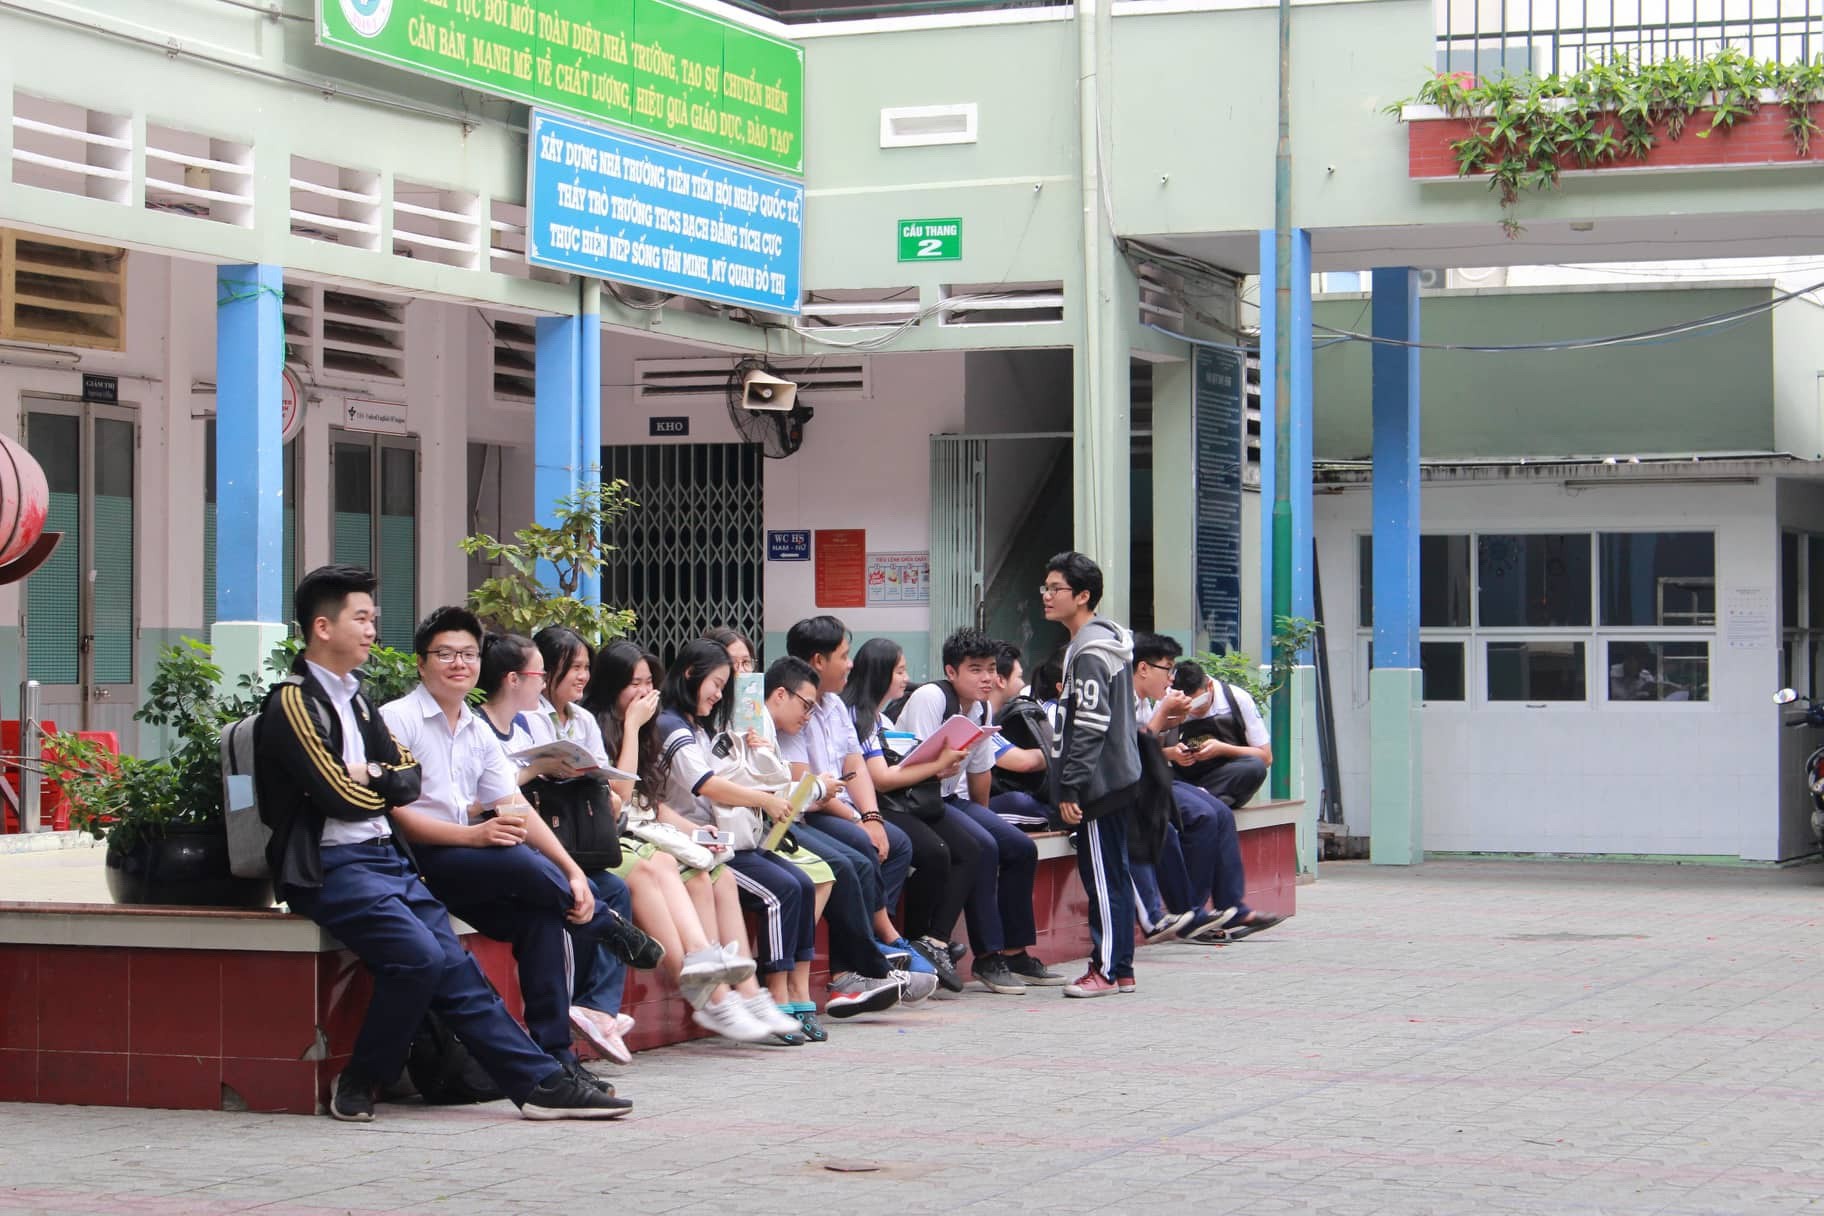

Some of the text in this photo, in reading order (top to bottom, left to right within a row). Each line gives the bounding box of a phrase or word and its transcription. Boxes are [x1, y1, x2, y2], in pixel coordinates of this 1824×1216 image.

[538, 9, 569, 46] TOÀN
[572, 21, 600, 58] DIỆN
[602, 31, 628, 64] NHÀ
[631, 40, 679, 85] TRƯỜNG,
[681, 58, 702, 92] TẠO
[705, 65, 720, 98] SỰ
[472, 37, 511, 75] MẠNH
[555, 56, 590, 97] CHẤT
[592, 72, 632, 115] LƯỢNG,
[636, 84, 665, 123] HIỆU
[691, 101, 717, 134] GIÁO
[720, 112, 745, 145] DỤC,
[747, 115, 768, 148] ĐÀO
[540, 131, 563, 163] XÂY
[565, 141, 597, 174] DỰNG
[598, 147, 621, 178] NHÀ
[622, 154, 665, 189] TRƯỜNG
[691, 168, 713, 202] TIẾN
[714, 176, 732, 211] HỘI
[733, 184, 759, 217] NHẬP
[760, 187, 786, 221] QUỐC
[588, 185, 609, 217] TRÒ
[611, 192, 653, 228] TRƯỜNG
[655, 206, 681, 234] THCS
[682, 213, 709, 243] BẠCH
[710, 211, 738, 248] ĐẰNG
[739, 221, 761, 253] TÍCH
[762, 232, 782, 261] CỰC
[917, 239, 943, 257] 2
[925, 224, 957, 237] THANG
[550, 222, 581, 257] THỰC
[582, 225, 608, 262] HIỆN
[609, 228, 631, 262] NẾP
[631, 233, 661, 269] SỐNG
[683, 252, 711, 285] MINH,
[728, 262, 755, 287] QUAN
[755, 263, 769, 292] ĐÔ
[770, 271, 786, 301] THỊ
[656, 422, 684, 432] KHO
[774, 534, 805, 544] WC HS
